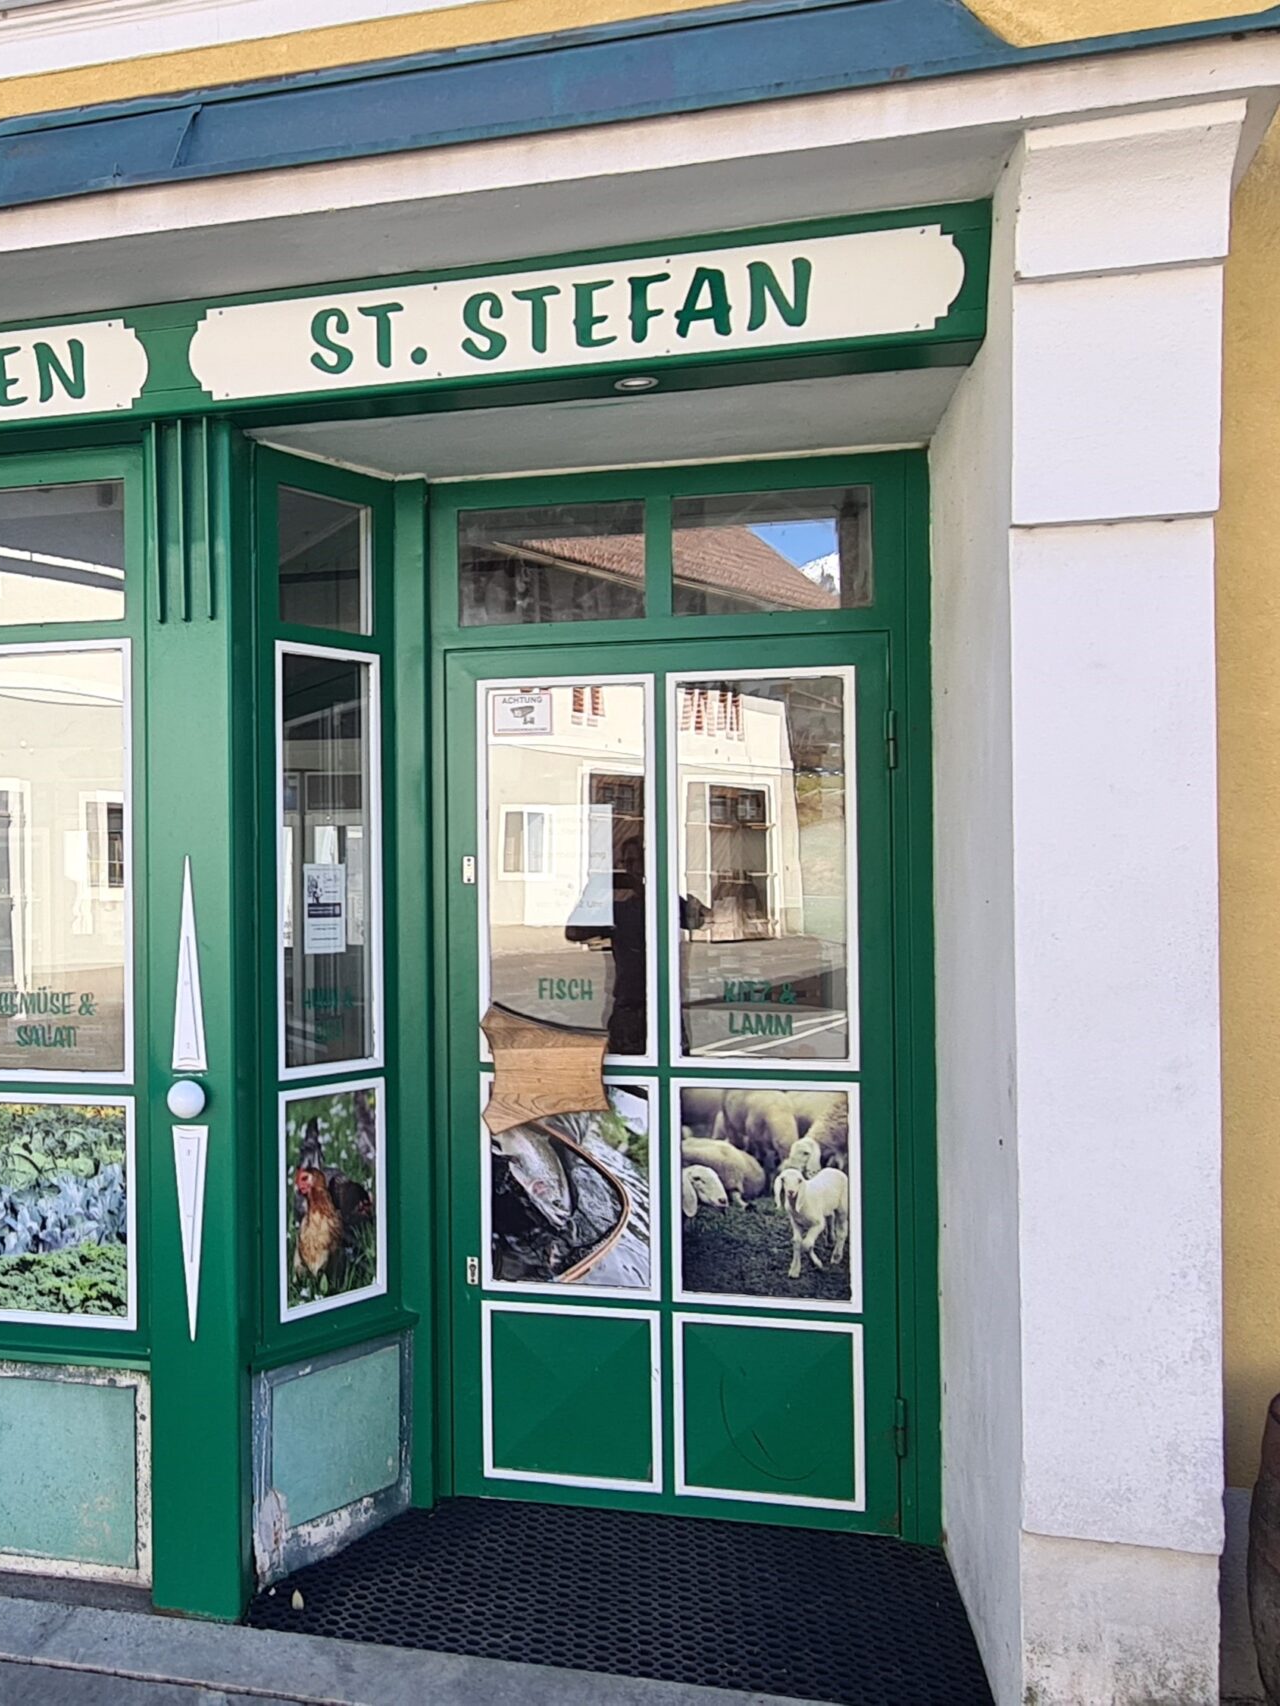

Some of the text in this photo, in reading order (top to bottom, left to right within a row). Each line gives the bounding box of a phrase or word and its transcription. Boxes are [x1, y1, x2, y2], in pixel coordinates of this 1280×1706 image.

[309, 256, 812, 375] ST. STEFAN
[502, 696, 542, 704] ACHTUNG
[537, 977, 593, 1001] FISCH
[78, 992, 96, 1015] &
[16, 1024, 77, 1047] SALAT
[729, 1012, 794, 1036] LAMM
